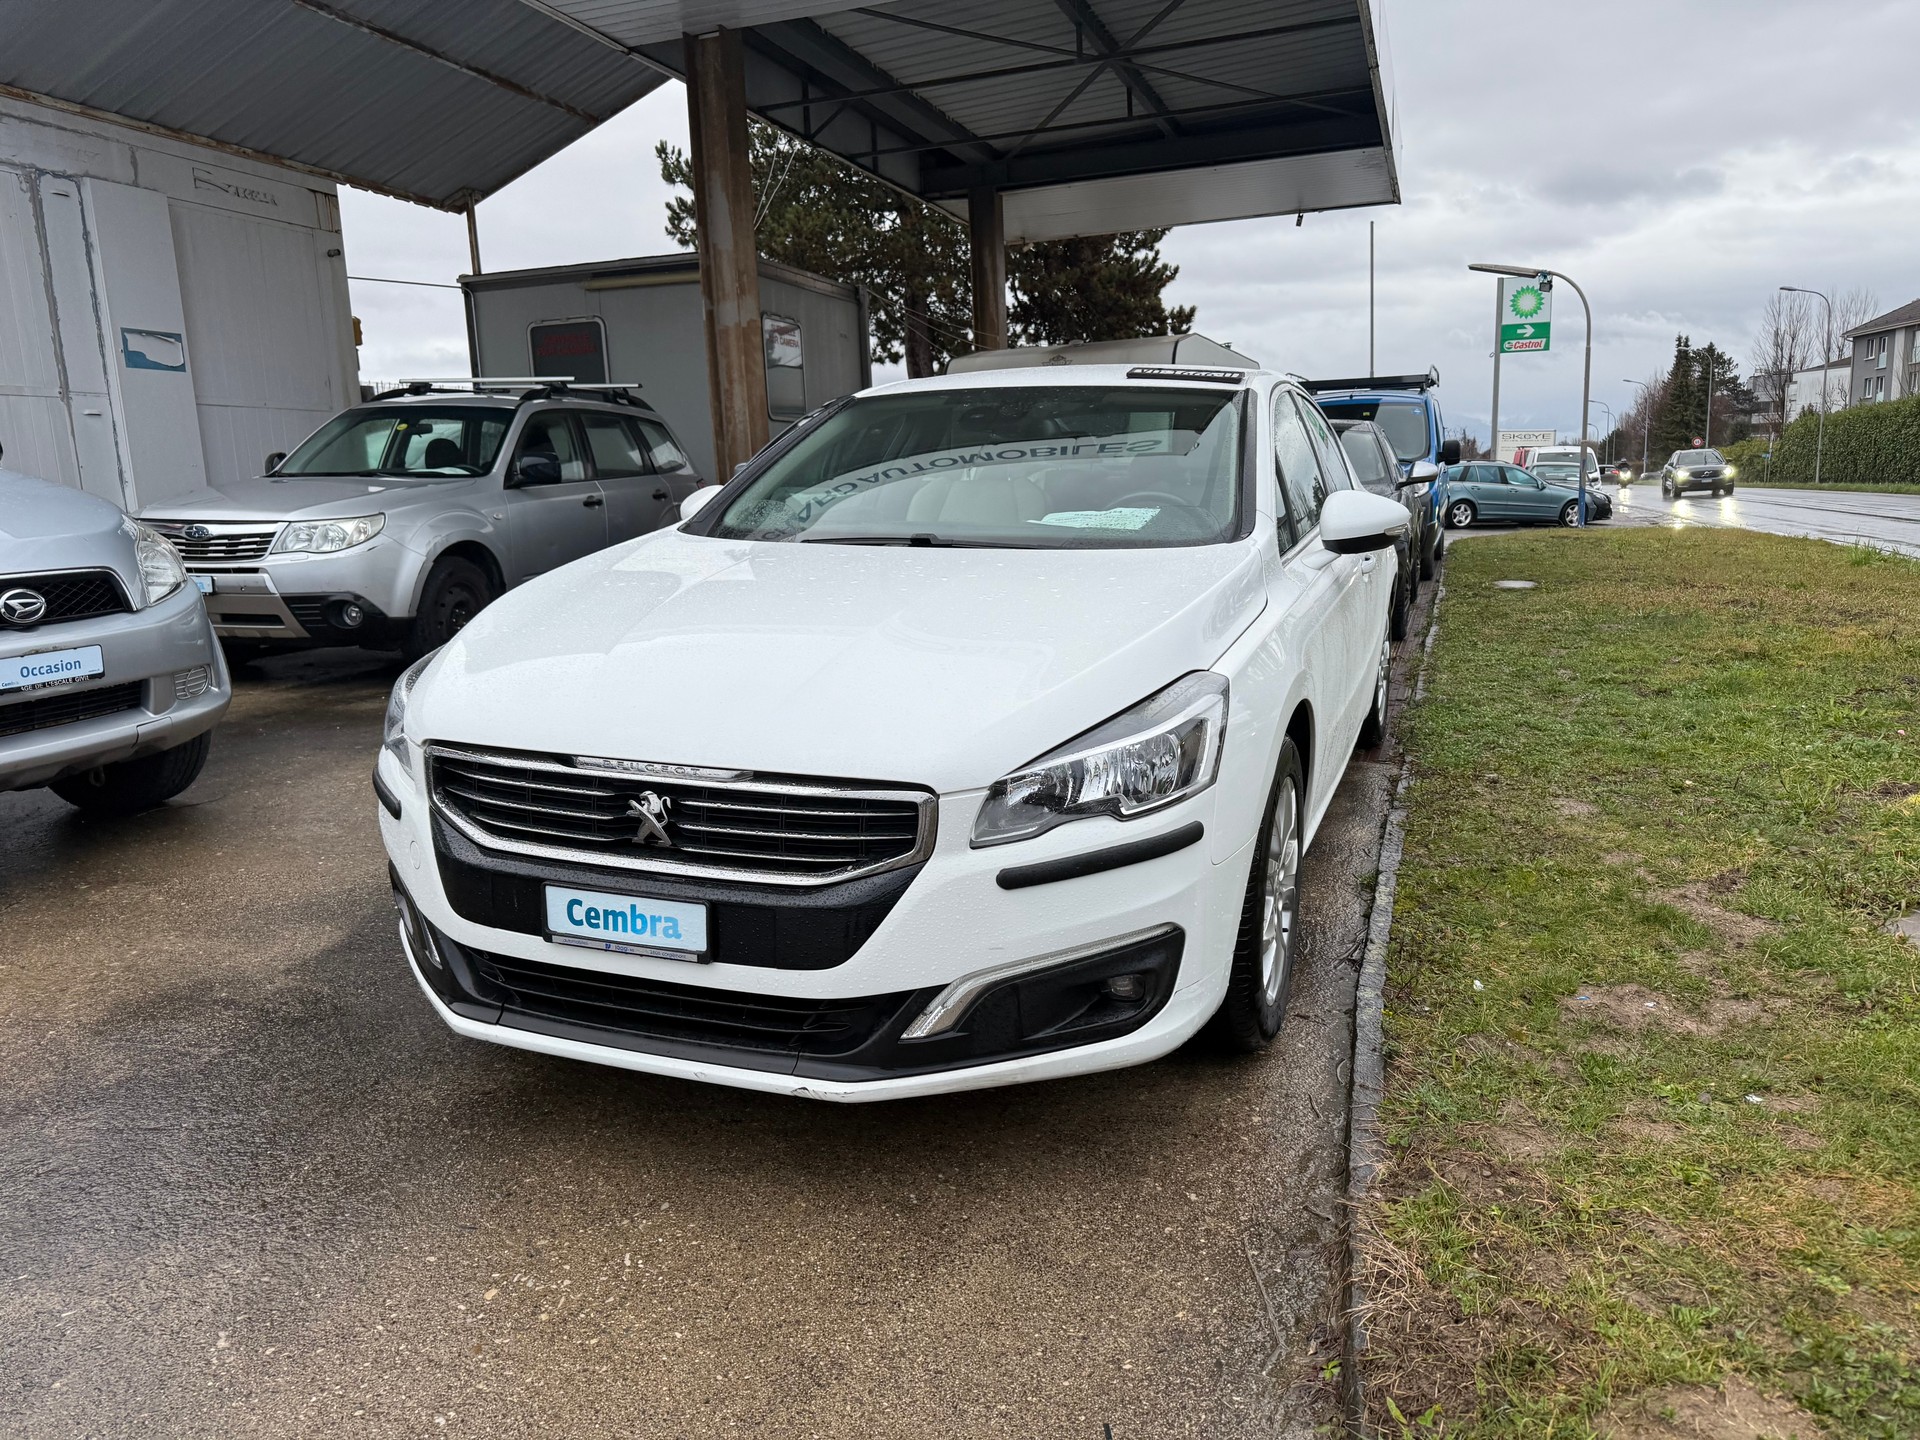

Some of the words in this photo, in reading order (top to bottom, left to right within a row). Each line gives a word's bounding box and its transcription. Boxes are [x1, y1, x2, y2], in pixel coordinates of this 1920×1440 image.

[780, 337, 799, 348] CAMERA
[1513, 340, 1543, 350] Castrol
[20, 660, 81, 678] Occasion
[45, 678, 72, 688] L'ESCALE
[603, 760, 700, 776] PEUGEOT
[566, 898, 682, 939] Cembra
